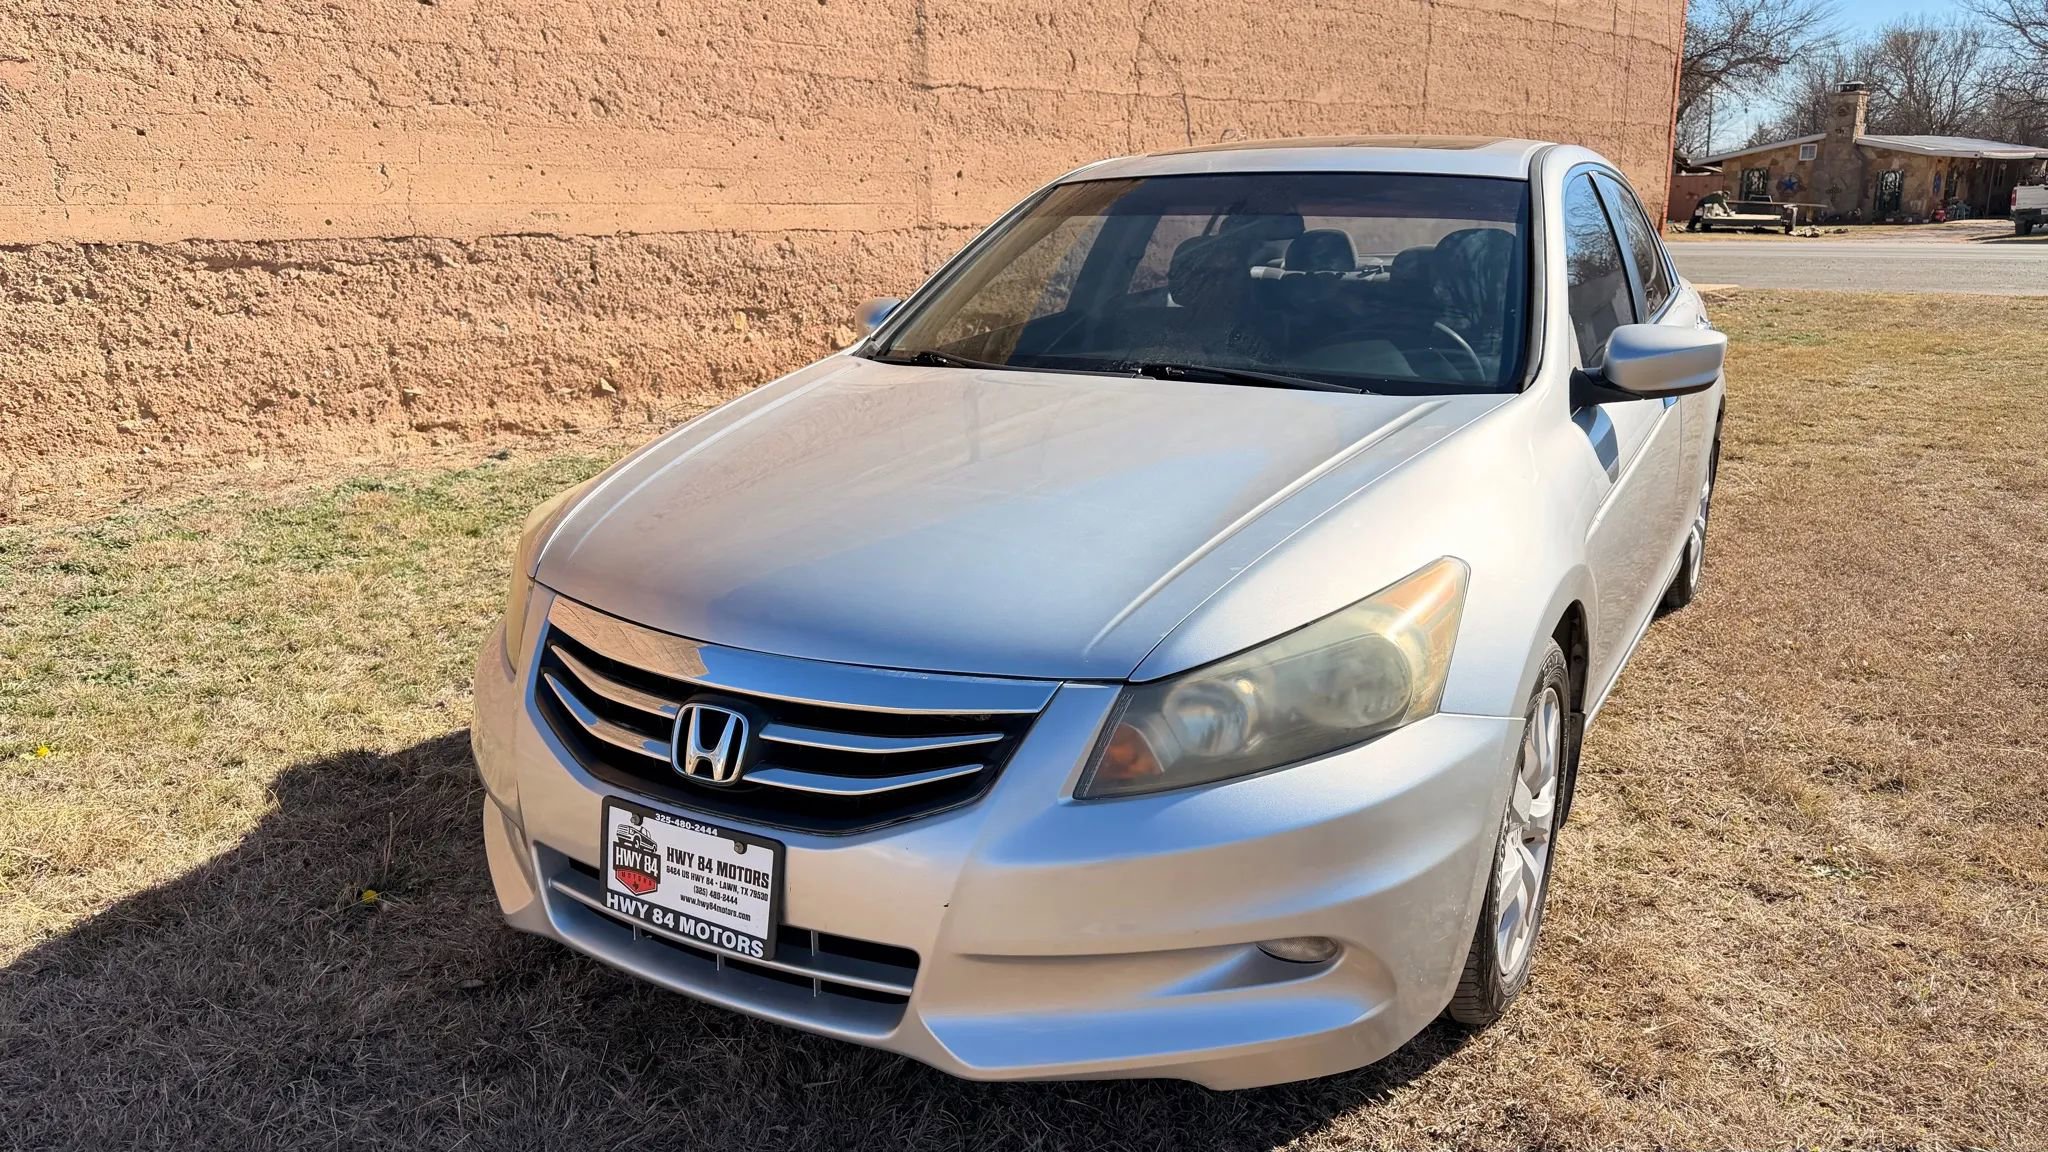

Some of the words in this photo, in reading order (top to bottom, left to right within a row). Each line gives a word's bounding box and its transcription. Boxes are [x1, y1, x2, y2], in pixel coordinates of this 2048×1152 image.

[655, 813, 718, 836] 325-480-2444
[615, 846, 642, 870] HWY
[644, 855, 658, 877] 84
[666, 846, 695, 869] HWY
[698, 856, 714, 873] 84
[716, 860, 770, 889] MOTORS
[681, 869, 690, 879] US
[690, 873, 705, 883] HWY
[705, 877, 714, 886] 84
[719, 880, 739, 895] LAWN,
[740, 886, 749, 896] TX
[750, 889, 769, 902] 79530
[693, 885, 708, 896] (325)
[709, 889, 738, 905] 480-2444
[680, 894, 751, 922] www.hwy84motors.com
[606, 892, 651, 920] HWY
[652, 908, 675, 929] 84
[679, 916, 765, 959] MOTORS
